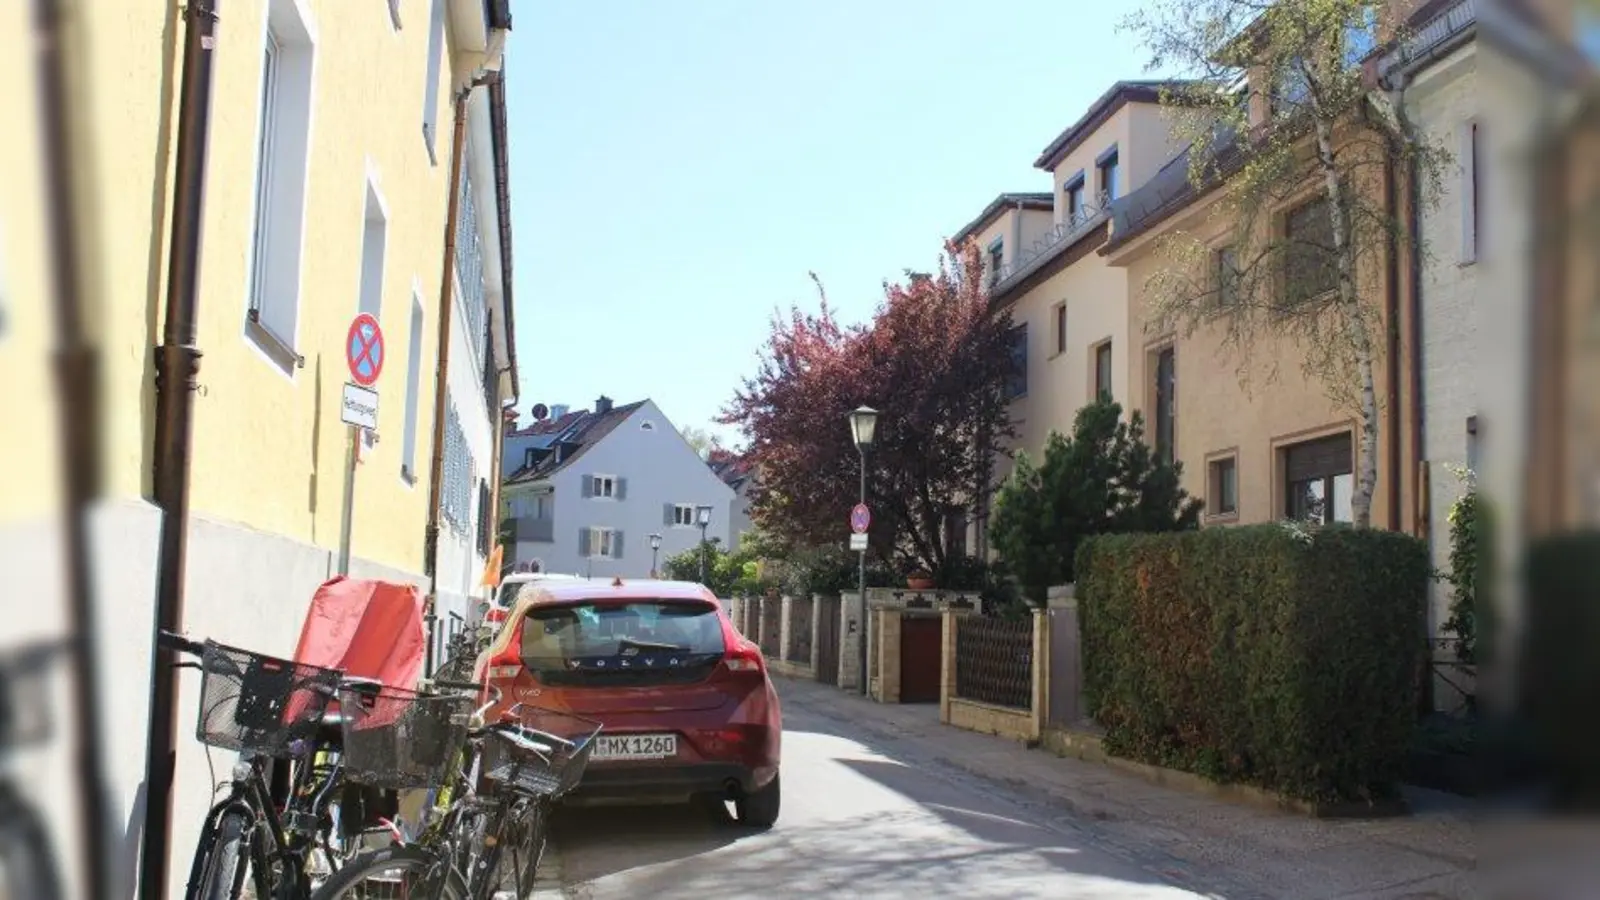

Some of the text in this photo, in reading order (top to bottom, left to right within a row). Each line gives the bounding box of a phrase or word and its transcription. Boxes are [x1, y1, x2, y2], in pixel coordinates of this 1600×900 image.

[571, 656, 678, 668] VOLVO
[608, 738, 630, 755] MX
[633, 737, 674, 754] 1260
